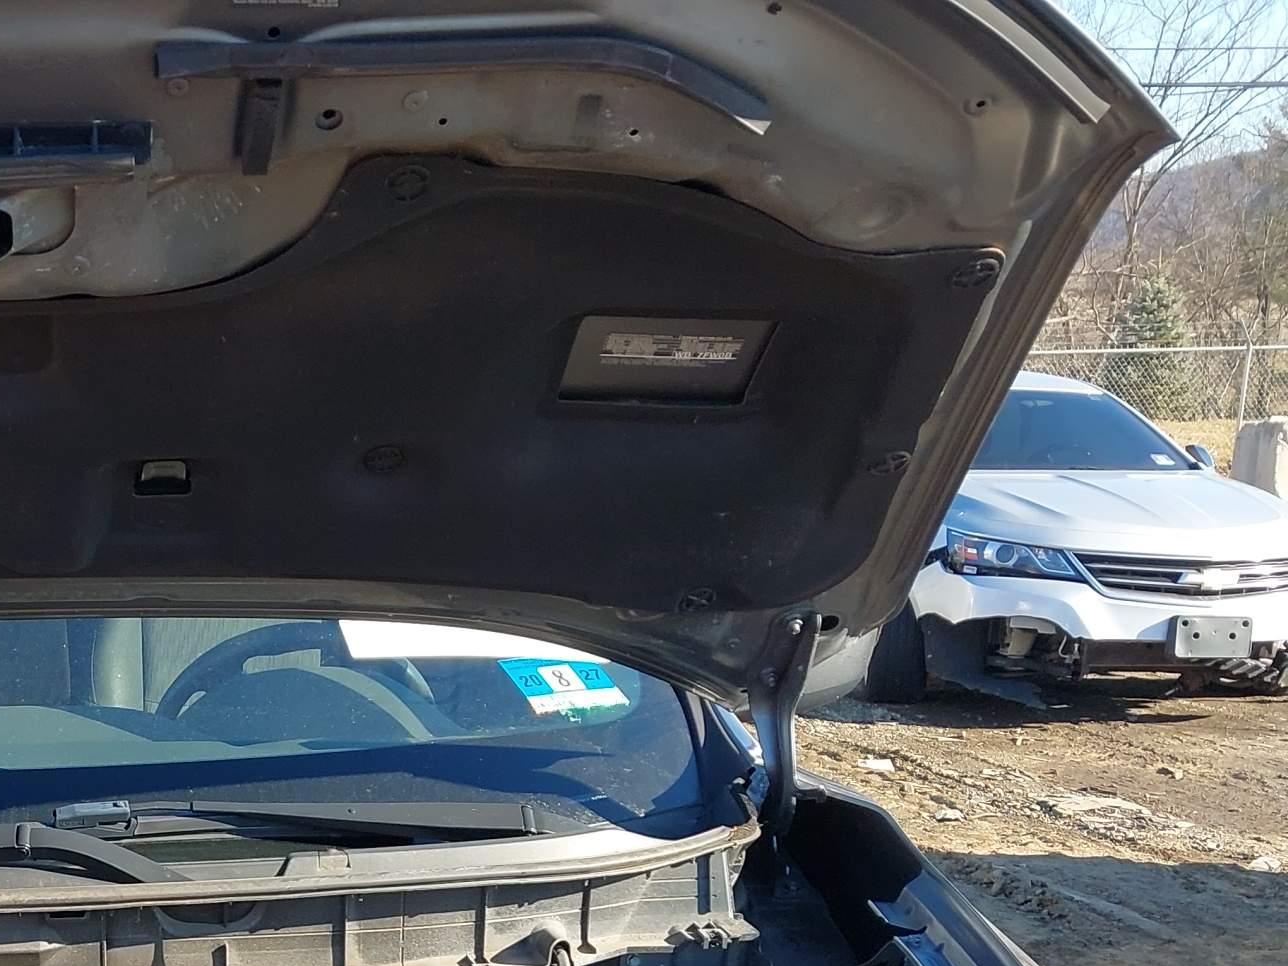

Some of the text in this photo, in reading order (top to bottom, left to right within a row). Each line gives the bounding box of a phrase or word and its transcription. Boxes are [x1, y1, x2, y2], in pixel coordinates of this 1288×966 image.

[519, 668, 601, 688] 20 8 27
